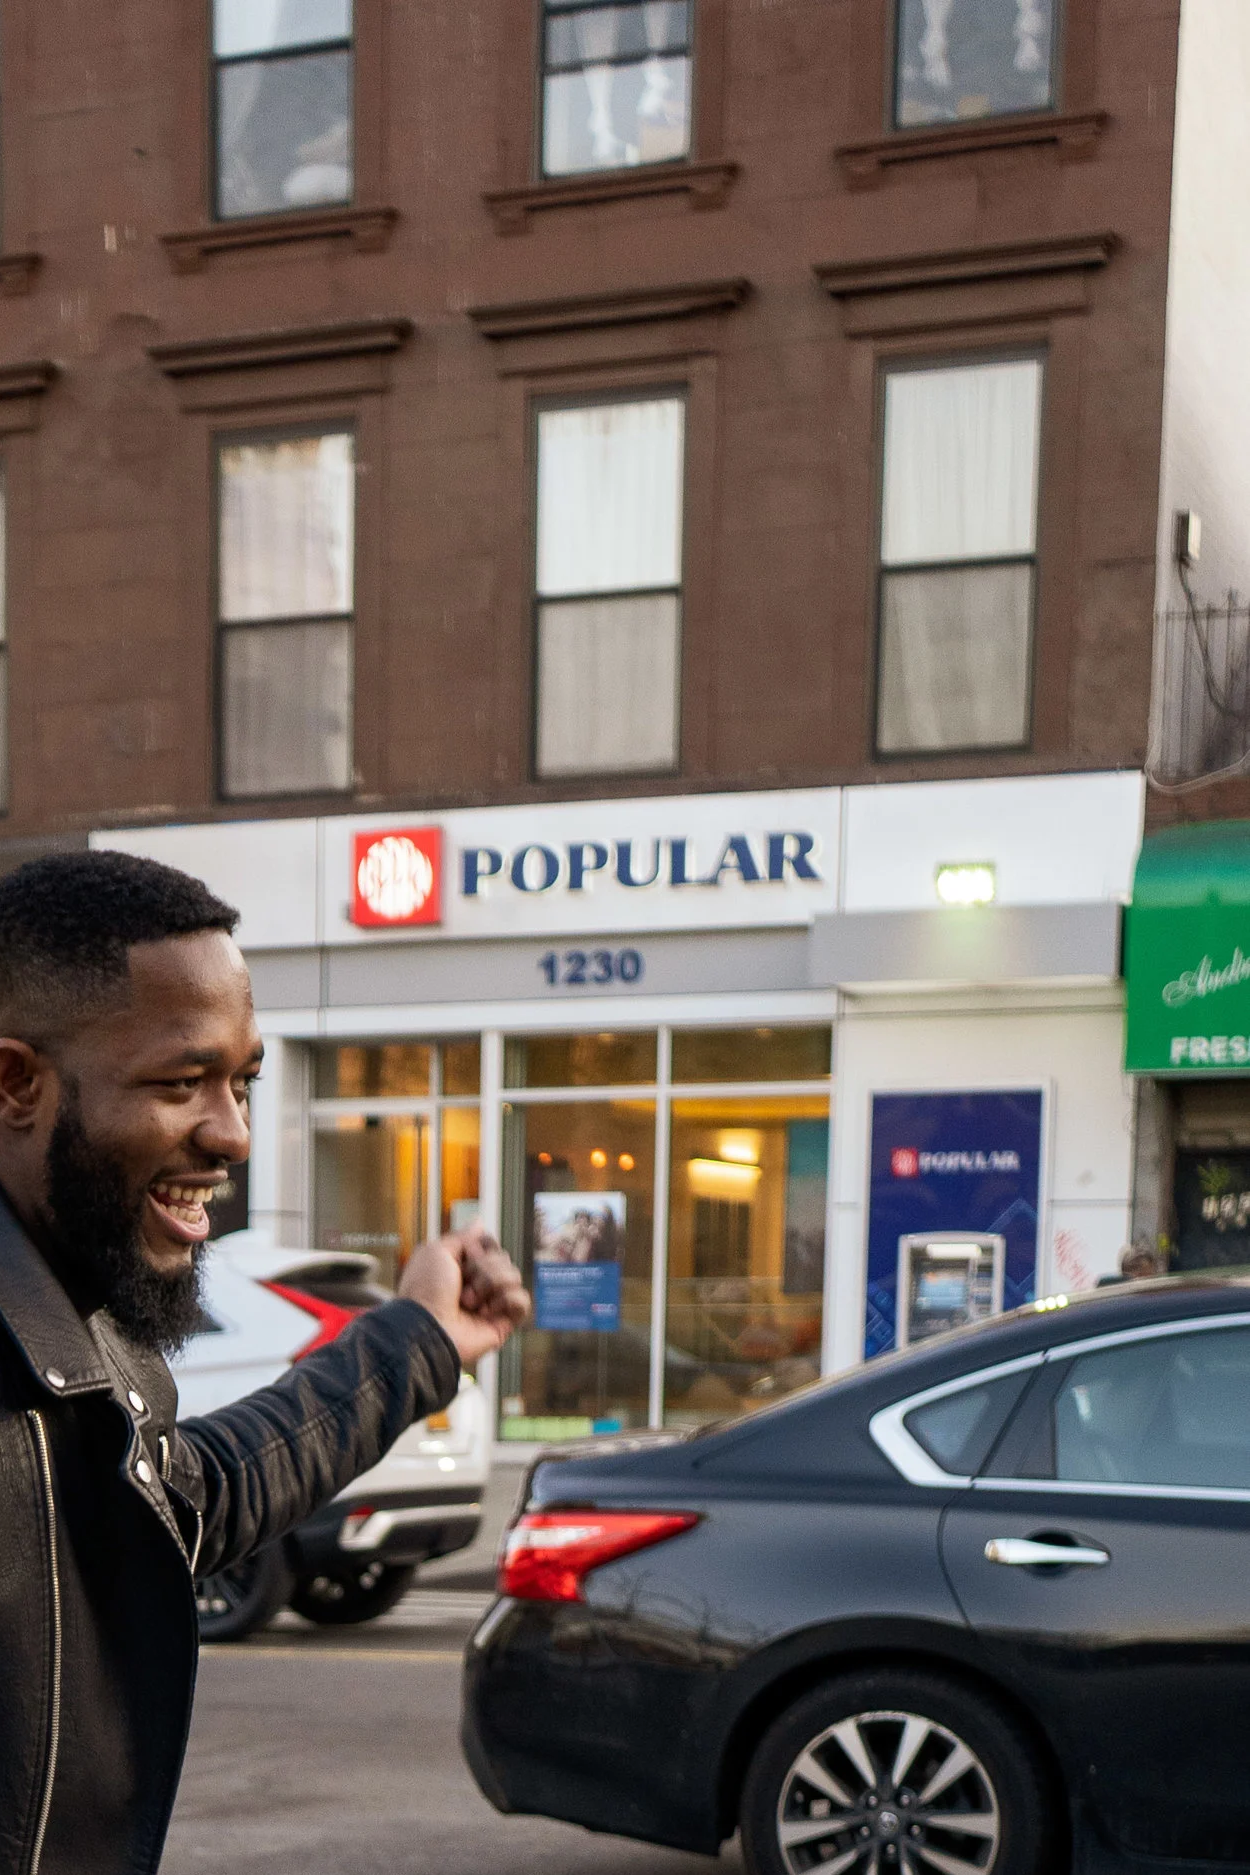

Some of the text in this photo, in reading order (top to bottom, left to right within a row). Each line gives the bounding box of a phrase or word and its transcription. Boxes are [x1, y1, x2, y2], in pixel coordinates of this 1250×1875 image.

[461, 831, 823, 897] POPULAR
[538, 947, 644, 986] 1230
[1171, 1035, 1250, 1065] FRES
[919, 1150, 1020, 1174] POPULAR
